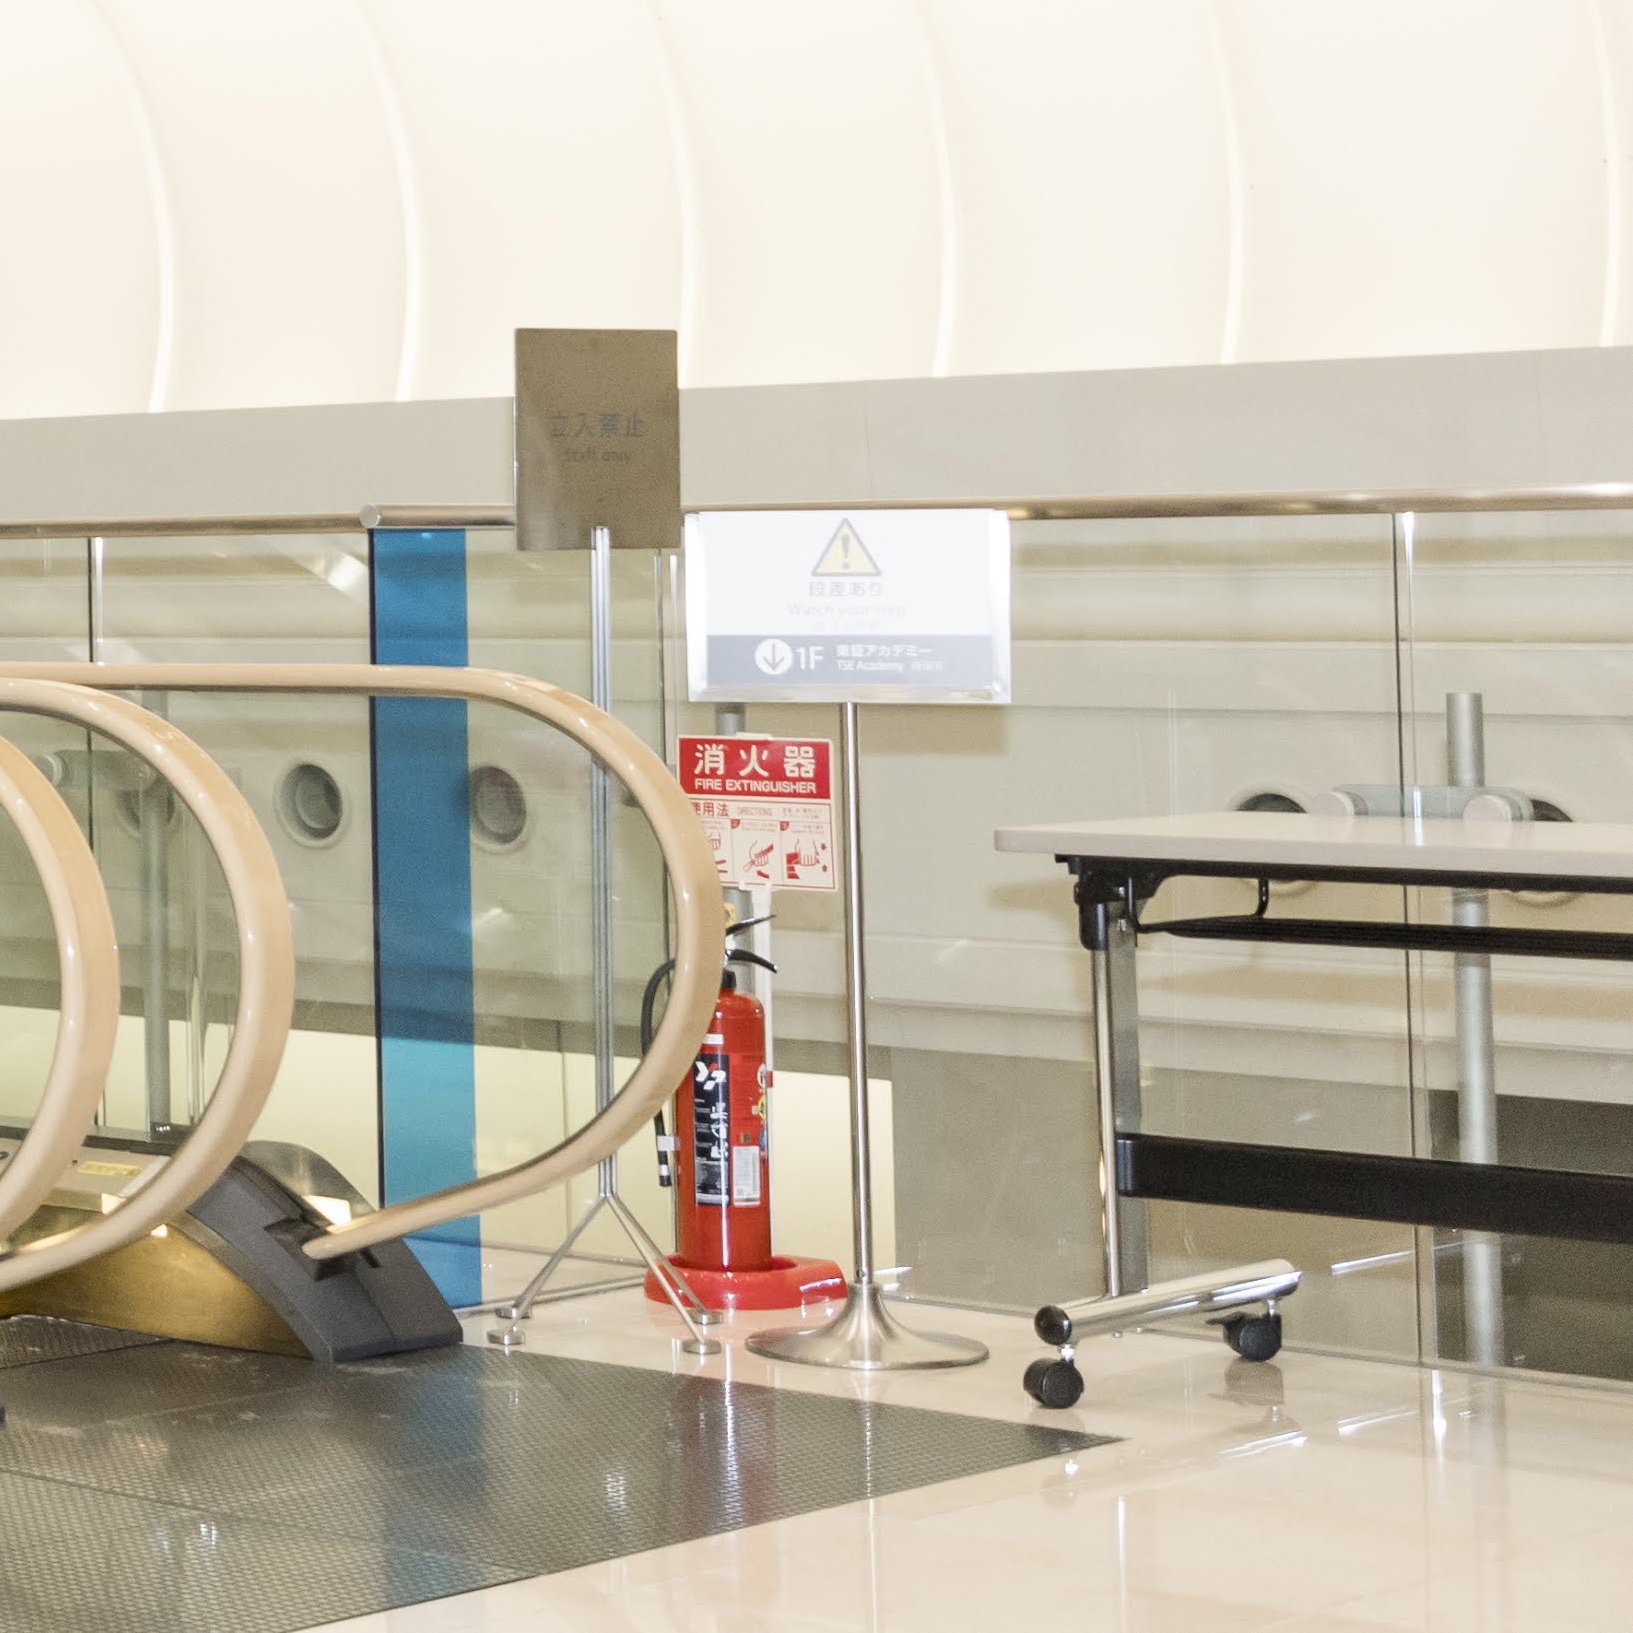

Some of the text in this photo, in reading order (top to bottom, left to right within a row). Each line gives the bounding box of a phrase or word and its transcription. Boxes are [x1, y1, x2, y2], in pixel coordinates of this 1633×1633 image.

[550, 411, 644, 438] 立入禁止
[809, 581, 882, 597] 段差あり
[789, 603, 833, 616] Watch
[838, 605, 870, 618] your
[796, 646, 824, 670] 1F
[837, 660, 855, 671] TSE
[857, 660, 904, 672] Academy
[694, 743, 816, 778] 消火器
[695, 778, 817, 794] FIRE EXTINGUISHER
